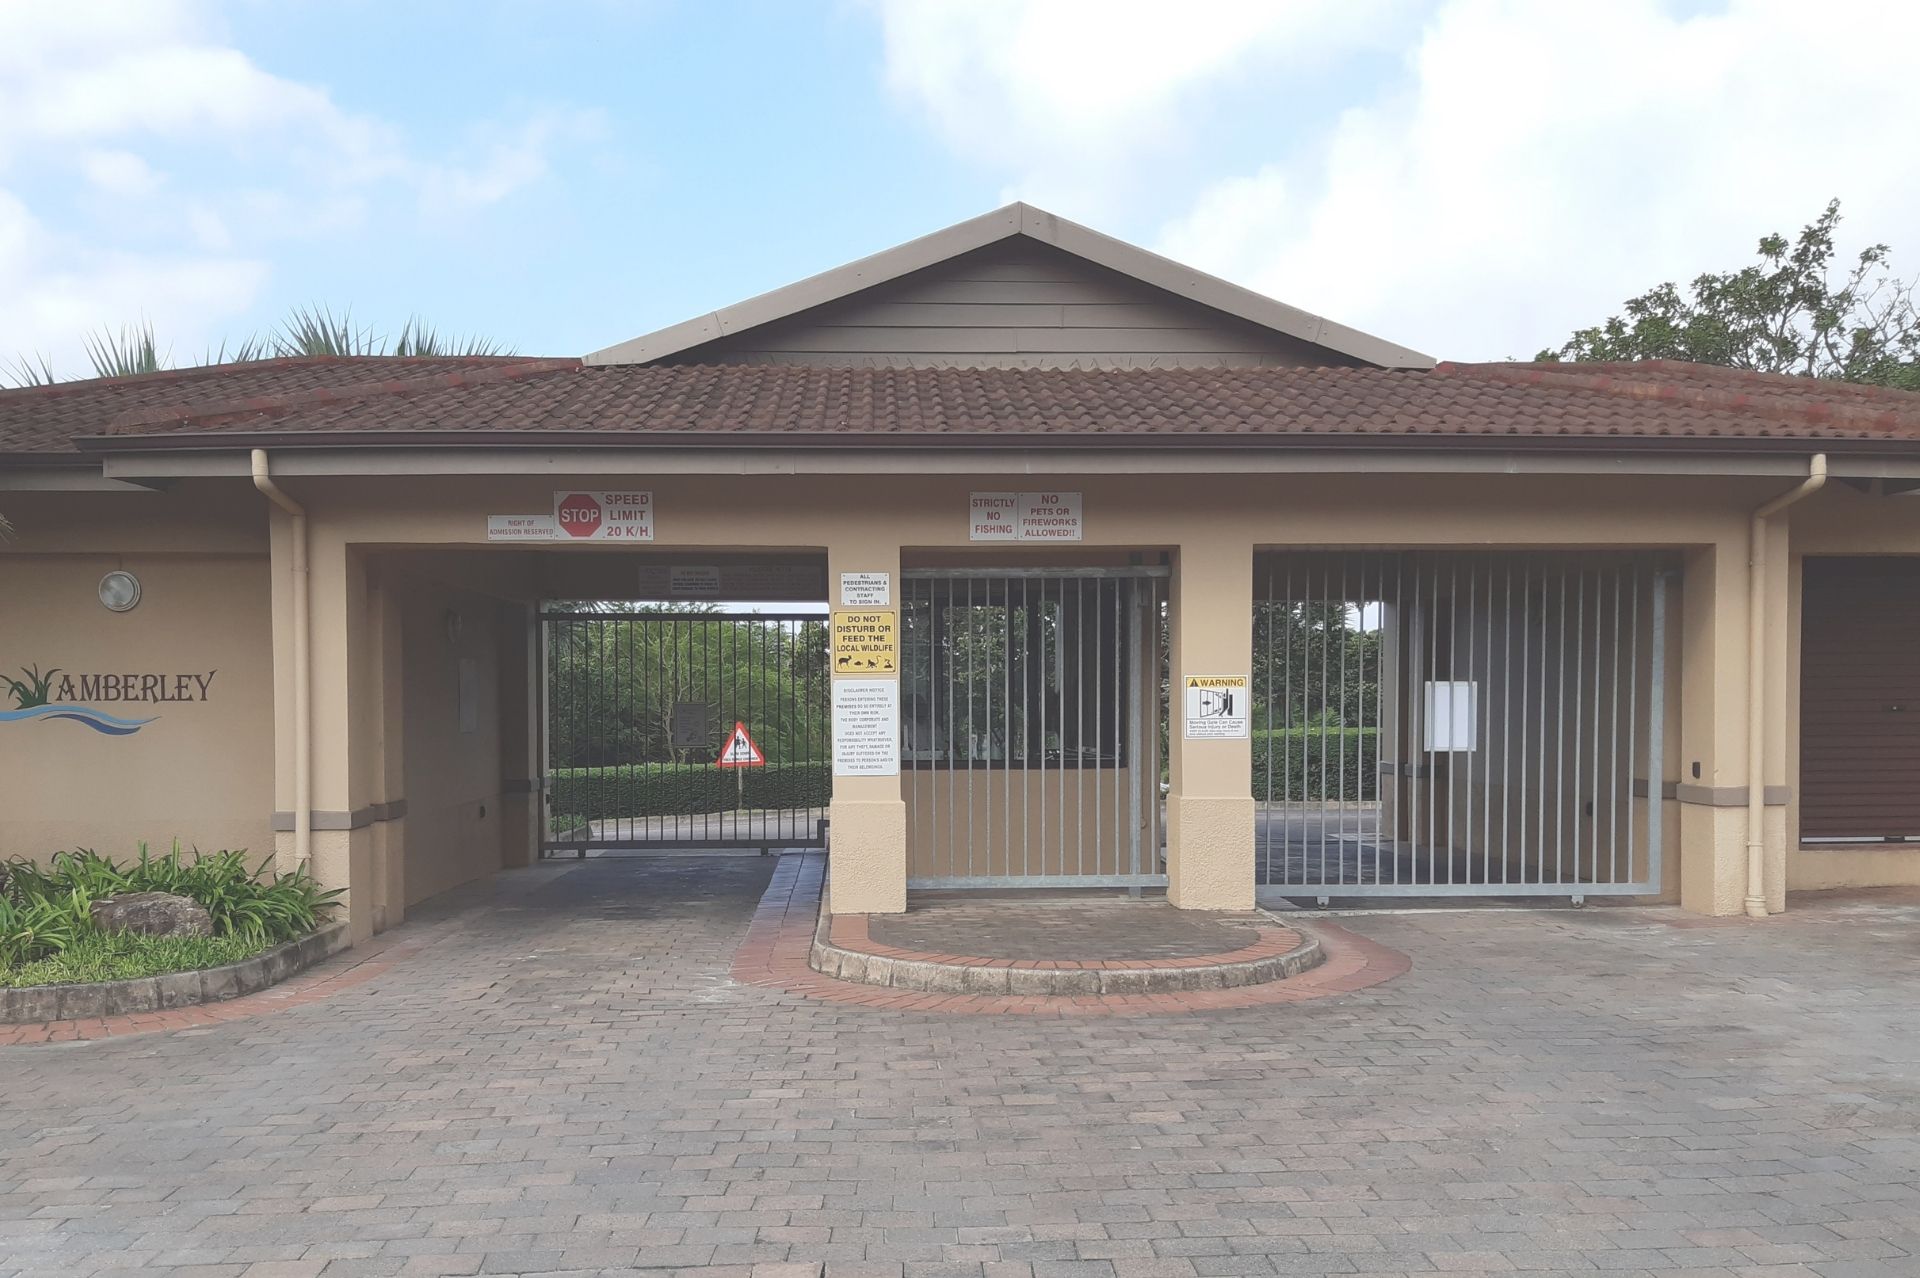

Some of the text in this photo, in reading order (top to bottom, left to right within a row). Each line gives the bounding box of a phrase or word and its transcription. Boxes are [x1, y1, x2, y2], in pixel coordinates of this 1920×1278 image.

[605, 495, 648, 505] SPEED
[972, 499, 1015, 507] STRICTLY
[1042, 495, 1058, 504] NO
[562, 509, 599, 522] STOP
[610, 510, 645, 520] LIMIT
[987, 512, 1000, 520] NO
[607, 527, 648, 536] 20 K/H
[975, 525, 1012, 533] FISHING
[56, 669, 218, 704] AMBERLEY
